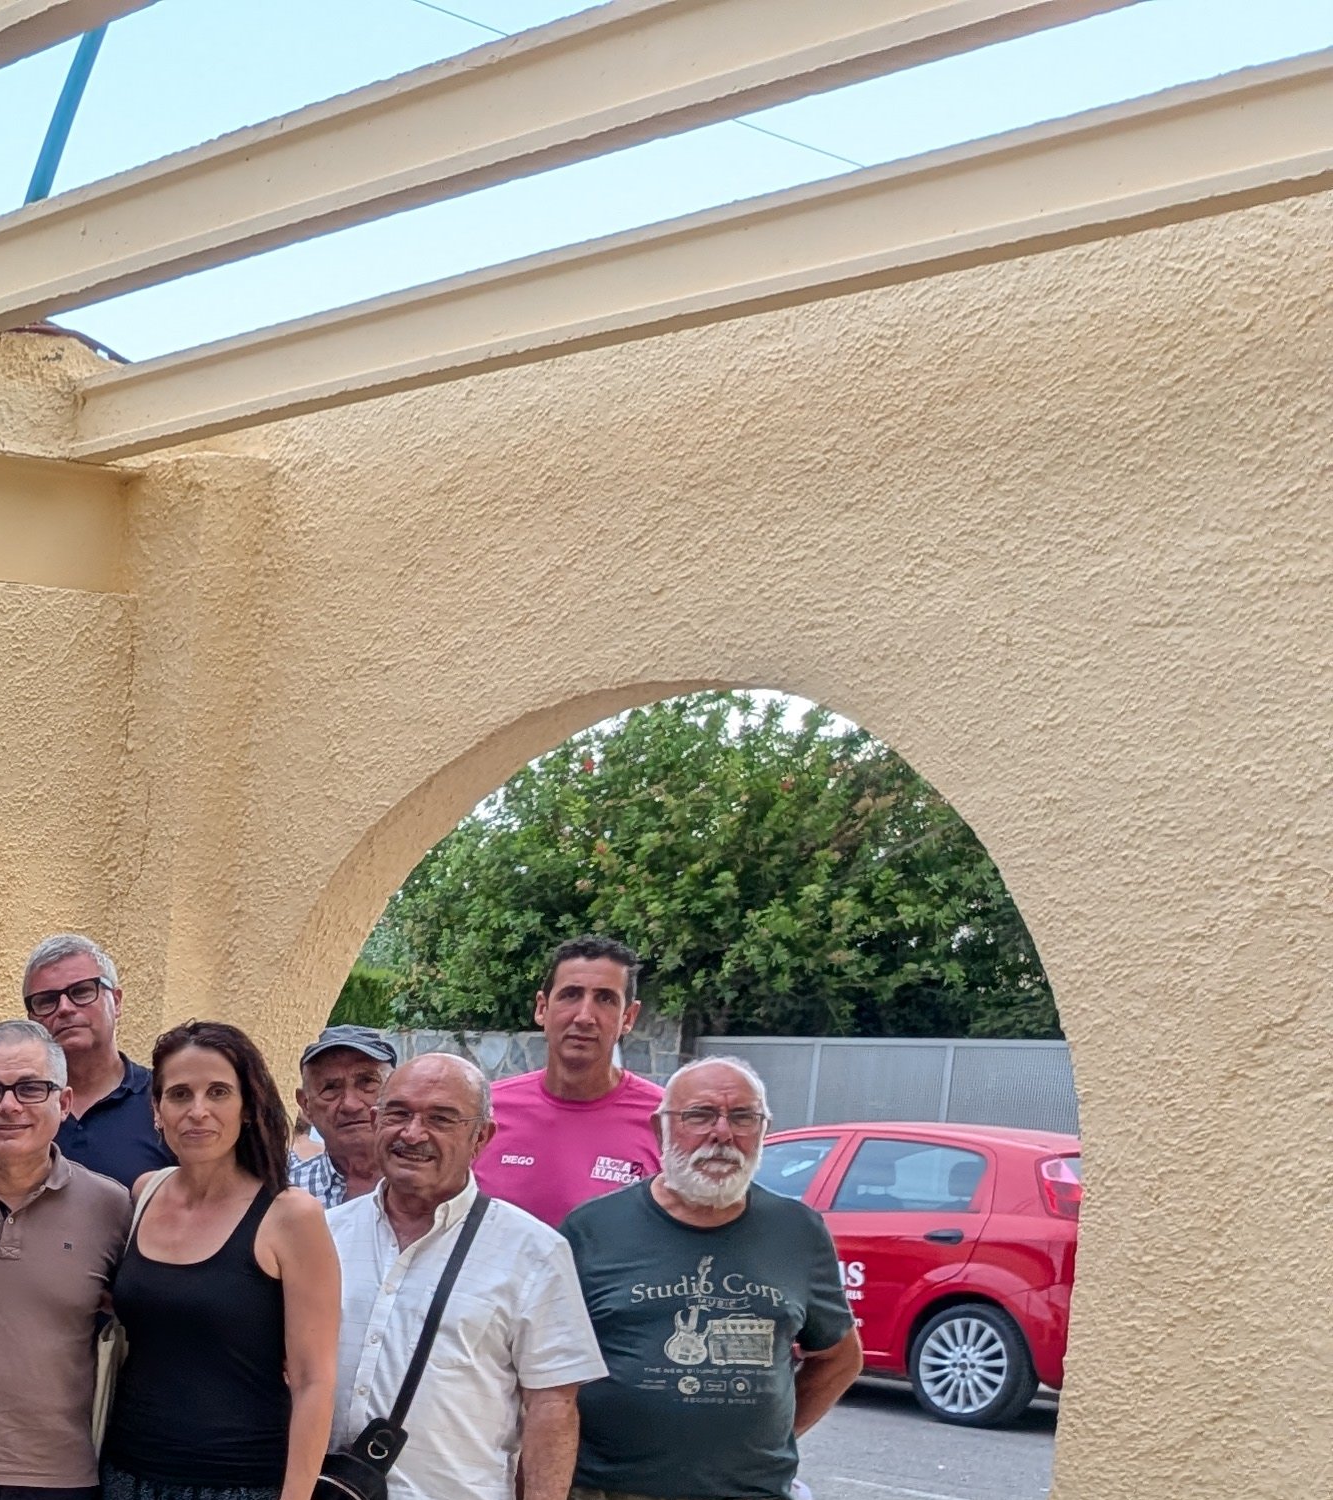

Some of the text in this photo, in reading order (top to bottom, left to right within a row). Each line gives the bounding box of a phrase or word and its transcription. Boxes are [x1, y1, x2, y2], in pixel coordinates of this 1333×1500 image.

[501, 1155, 534, 1165] DIEGO
[631, 1273, 790, 1307] Studio Corp.
